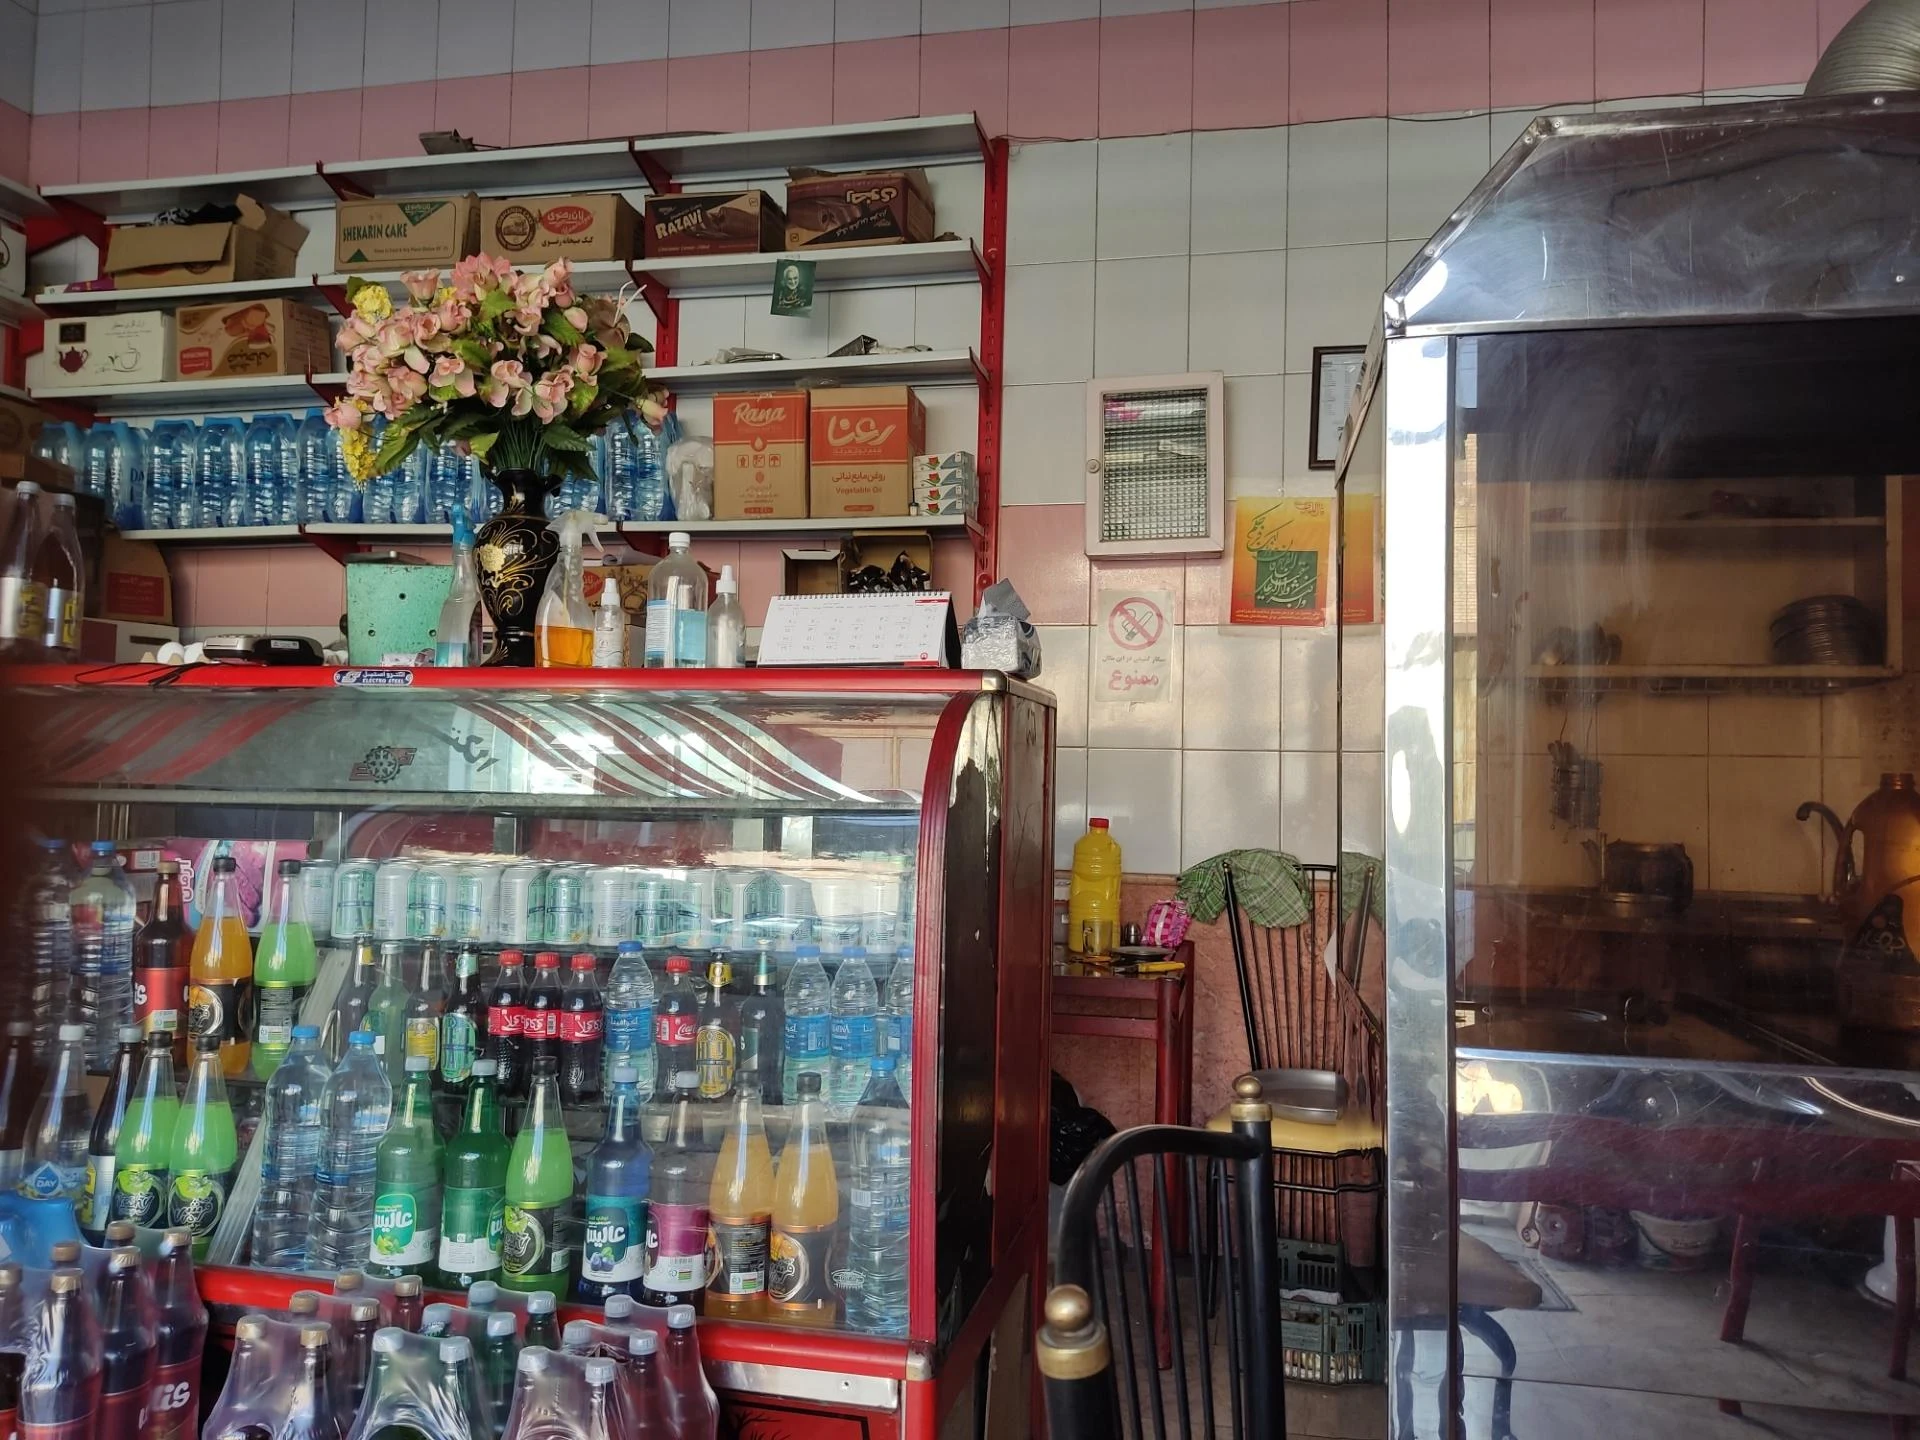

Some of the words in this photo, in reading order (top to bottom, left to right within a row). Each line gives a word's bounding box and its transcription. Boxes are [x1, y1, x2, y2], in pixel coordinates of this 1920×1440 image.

[343, 225, 383, 242] SHEKARIN
[384, 223, 408, 239] CAKE
[655, 209, 703, 240] RAZAVI
[733, 402, 787, 427] Rana
[827, 415, 897, 446] رعنا
[831, 471, 851, 483] نباتی
[851, 471, 868, 483] مایع
[868, 472, 886, 483] روغن
[835, 487, 871, 495] Vegetable
[1108, 669, 1160, 691] ممنوع
[36, 1179, 57, 1188] DAY
[586, 1225, 626, 1248] عالیس
